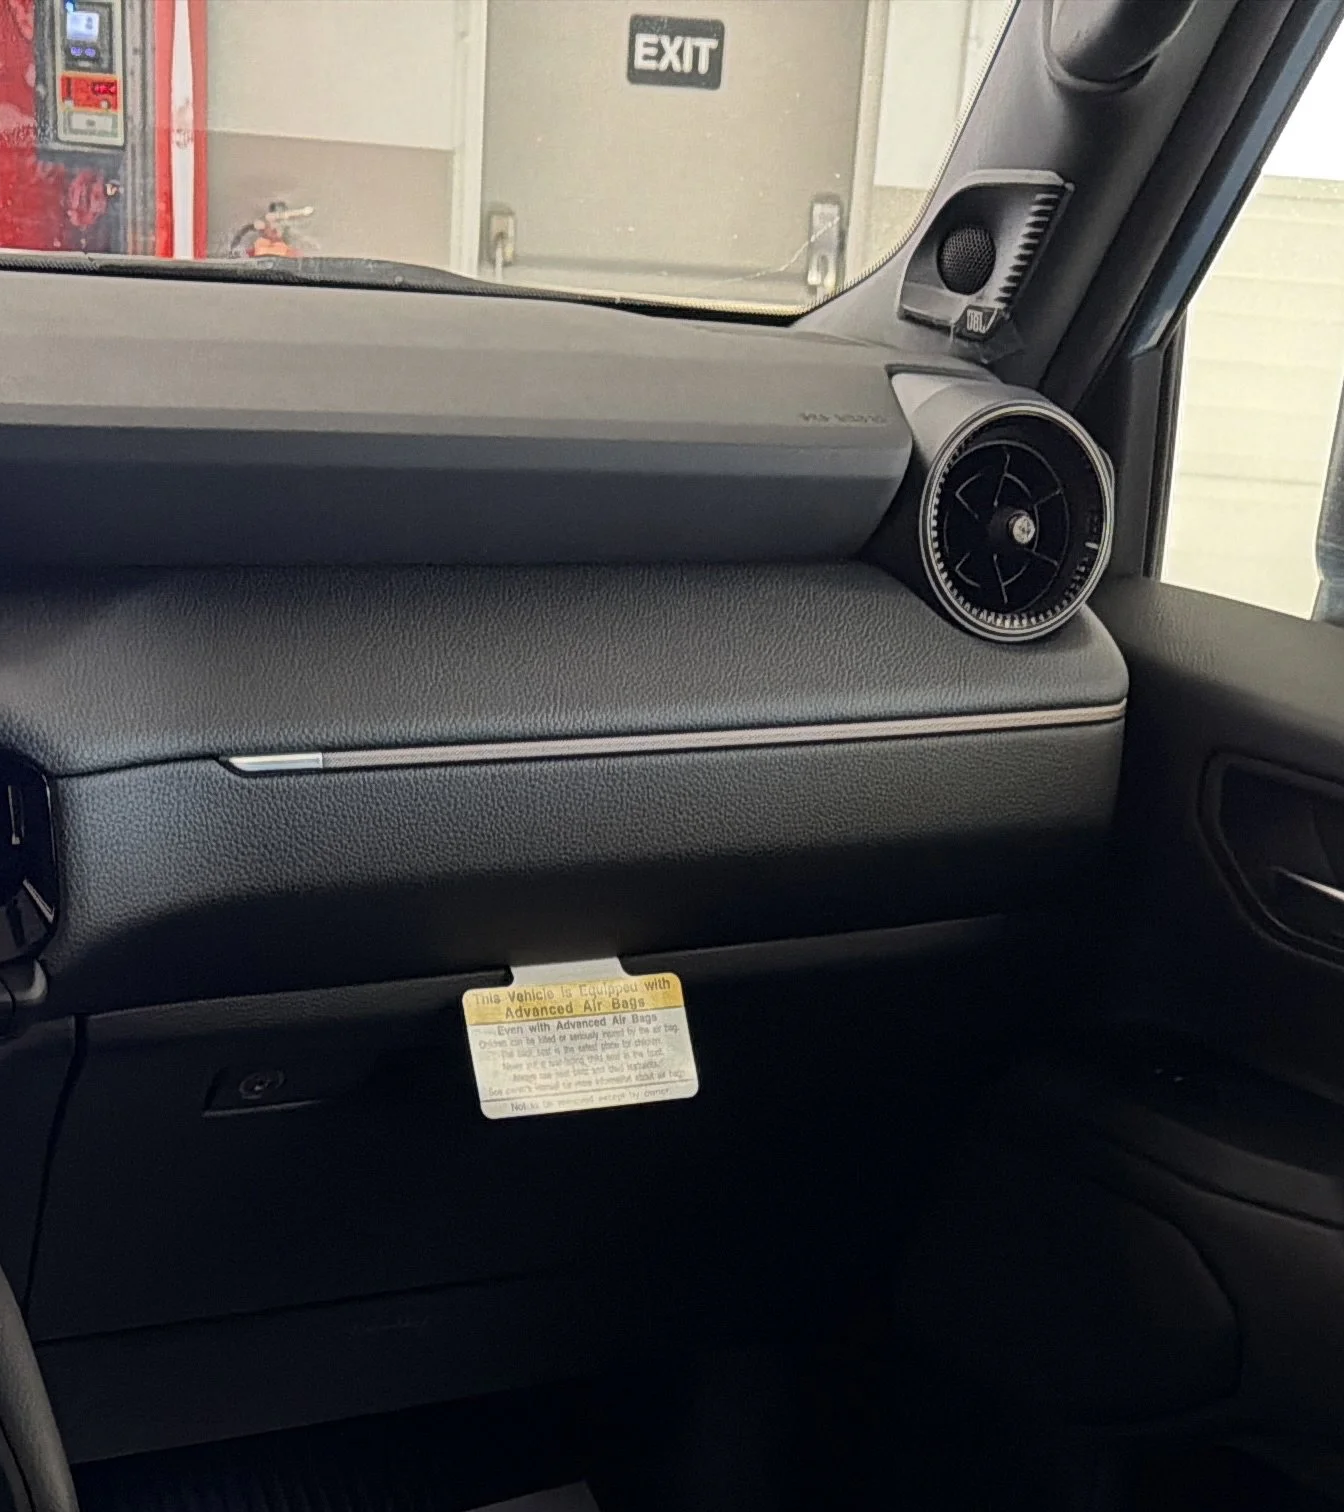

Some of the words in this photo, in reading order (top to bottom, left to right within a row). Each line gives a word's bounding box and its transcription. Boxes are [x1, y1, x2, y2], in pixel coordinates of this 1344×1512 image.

[633, 32, 719, 75] EXIT
[472, 992, 502, 1005] This
[507, 988, 555, 1003] Vehicle
[579, 982, 639, 998] Equipped
[644, 977, 671, 992] with
[505, 1001, 574, 1019] Advanced
[583, 999, 603, 1013] Air
[611, 997, 646, 1010] Bags
[497, 1025, 524, 1036] Even
[528, 1022, 551, 1033] with
[556, 1017, 607, 1031] Advanced
[612, 1015, 627, 1026] Air
[632, 1013, 658, 1024] Bags
